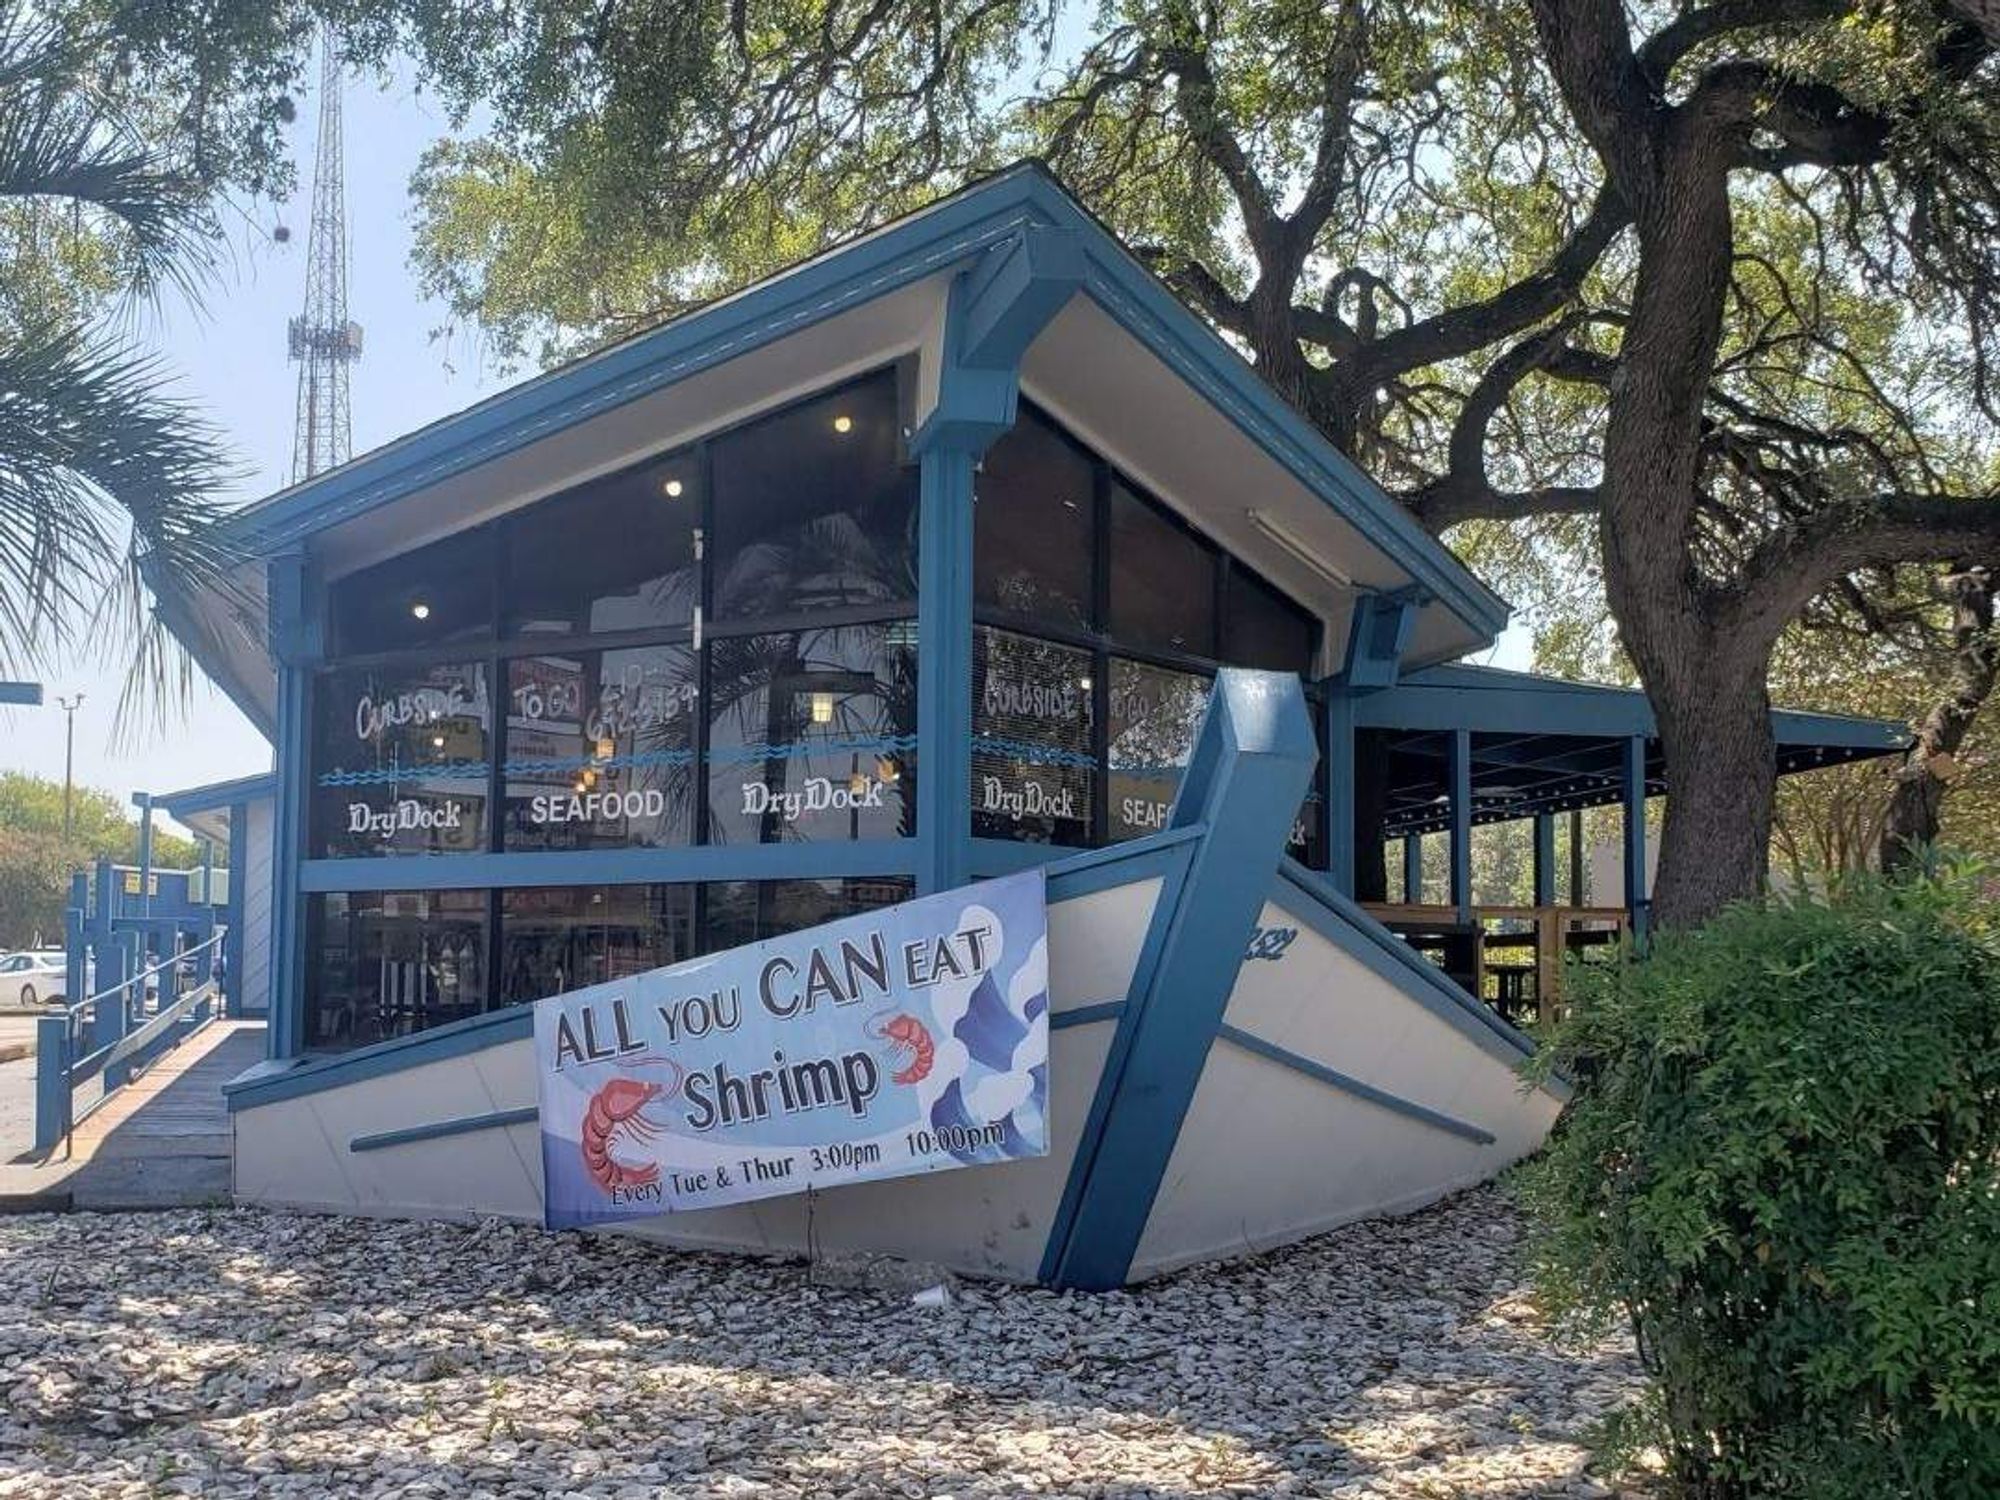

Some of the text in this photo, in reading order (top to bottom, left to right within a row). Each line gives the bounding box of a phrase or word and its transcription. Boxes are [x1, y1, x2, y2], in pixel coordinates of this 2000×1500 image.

[530, 789, 664, 824] SEAFOOD
[553, 925, 992, 1072] ALL YOU CAN EAT
[682, 1048, 879, 1132] Shrimp
[611, 1121, 1005, 1206] Every Tue & Thur 3:00pm 10:00pm
